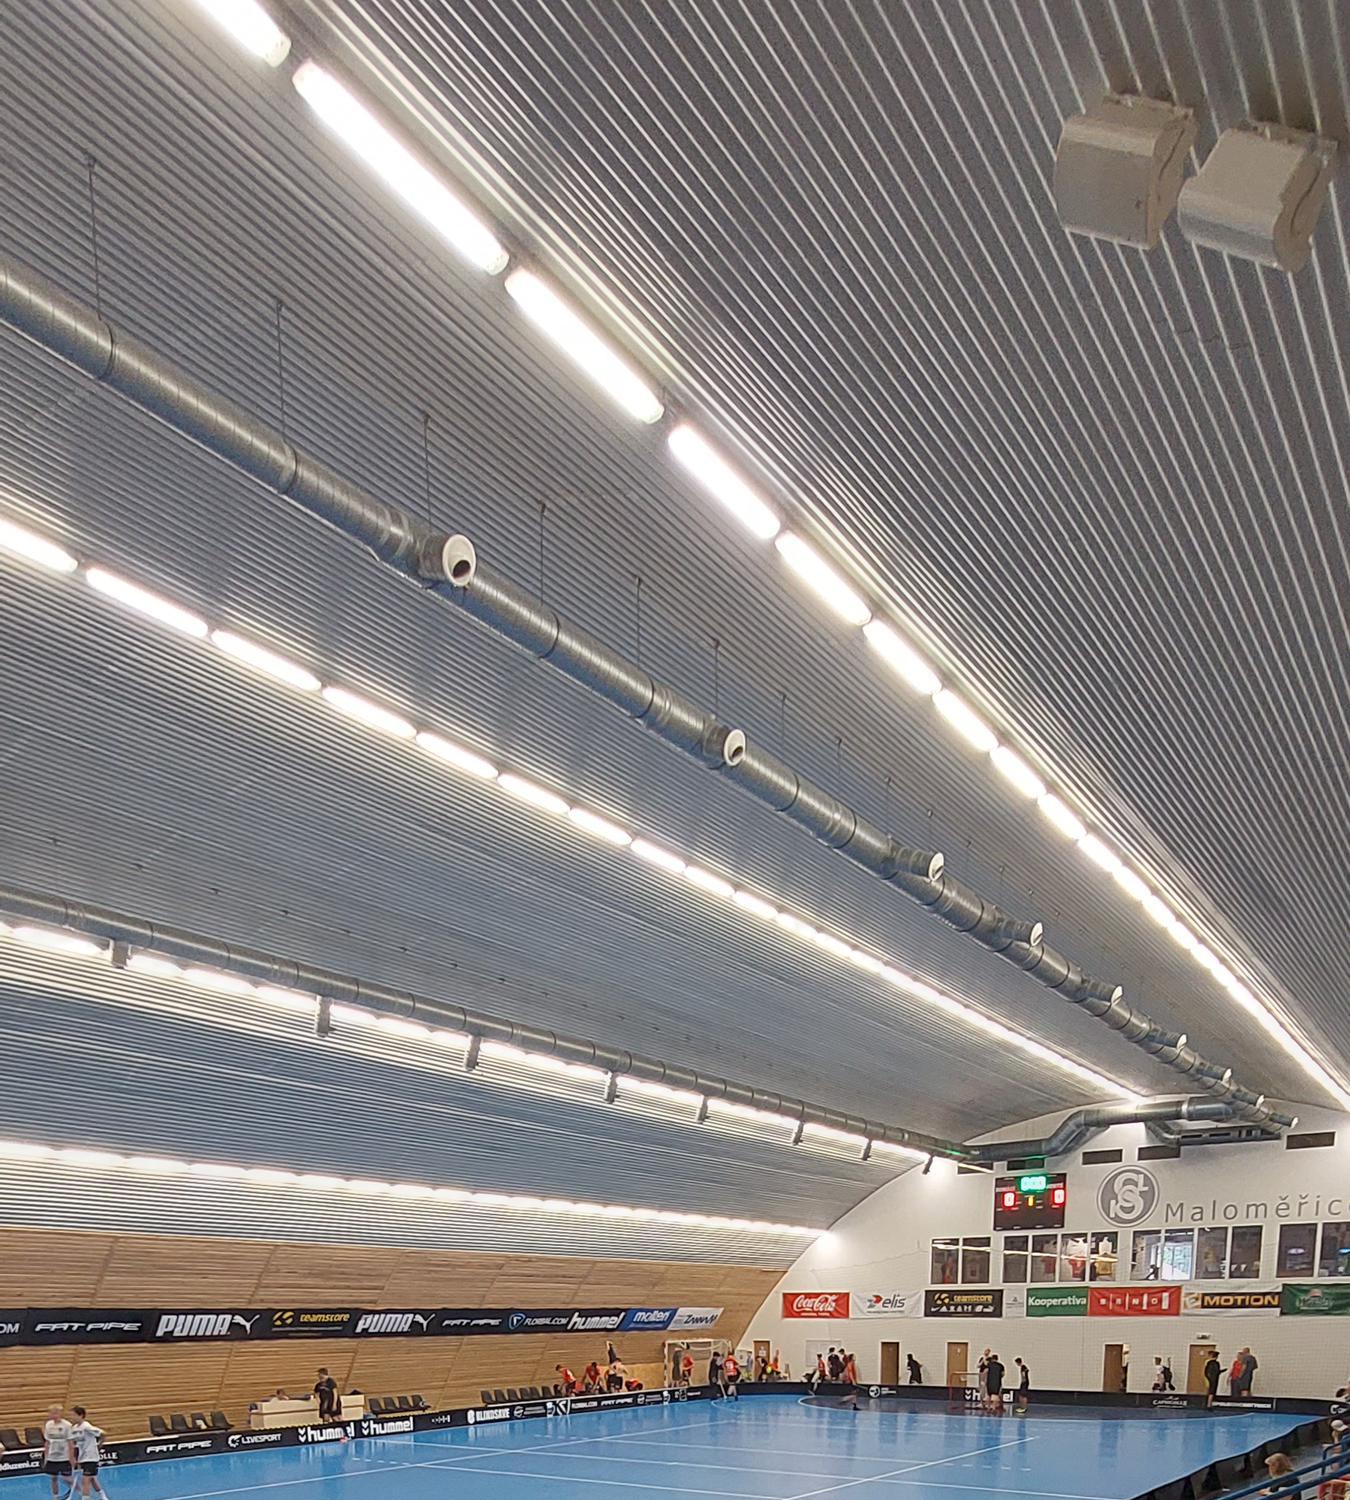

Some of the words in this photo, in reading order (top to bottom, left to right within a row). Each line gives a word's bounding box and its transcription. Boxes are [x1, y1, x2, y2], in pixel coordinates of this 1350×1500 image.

[1165, 1194, 1350, 1223] Maloměřic
[1028, 1295, 1087, 1307] Kooperativa
[35, 1322, 86, 1332] FAT
[86, 1322, 142, 1331] PIPE
[156, 1314, 232, 1337] PUMA
[355, 1313, 414, 1333] PUMA
[567, 1311, 626, 1330] hummel
[370, 1416, 414, 1435] hummel
